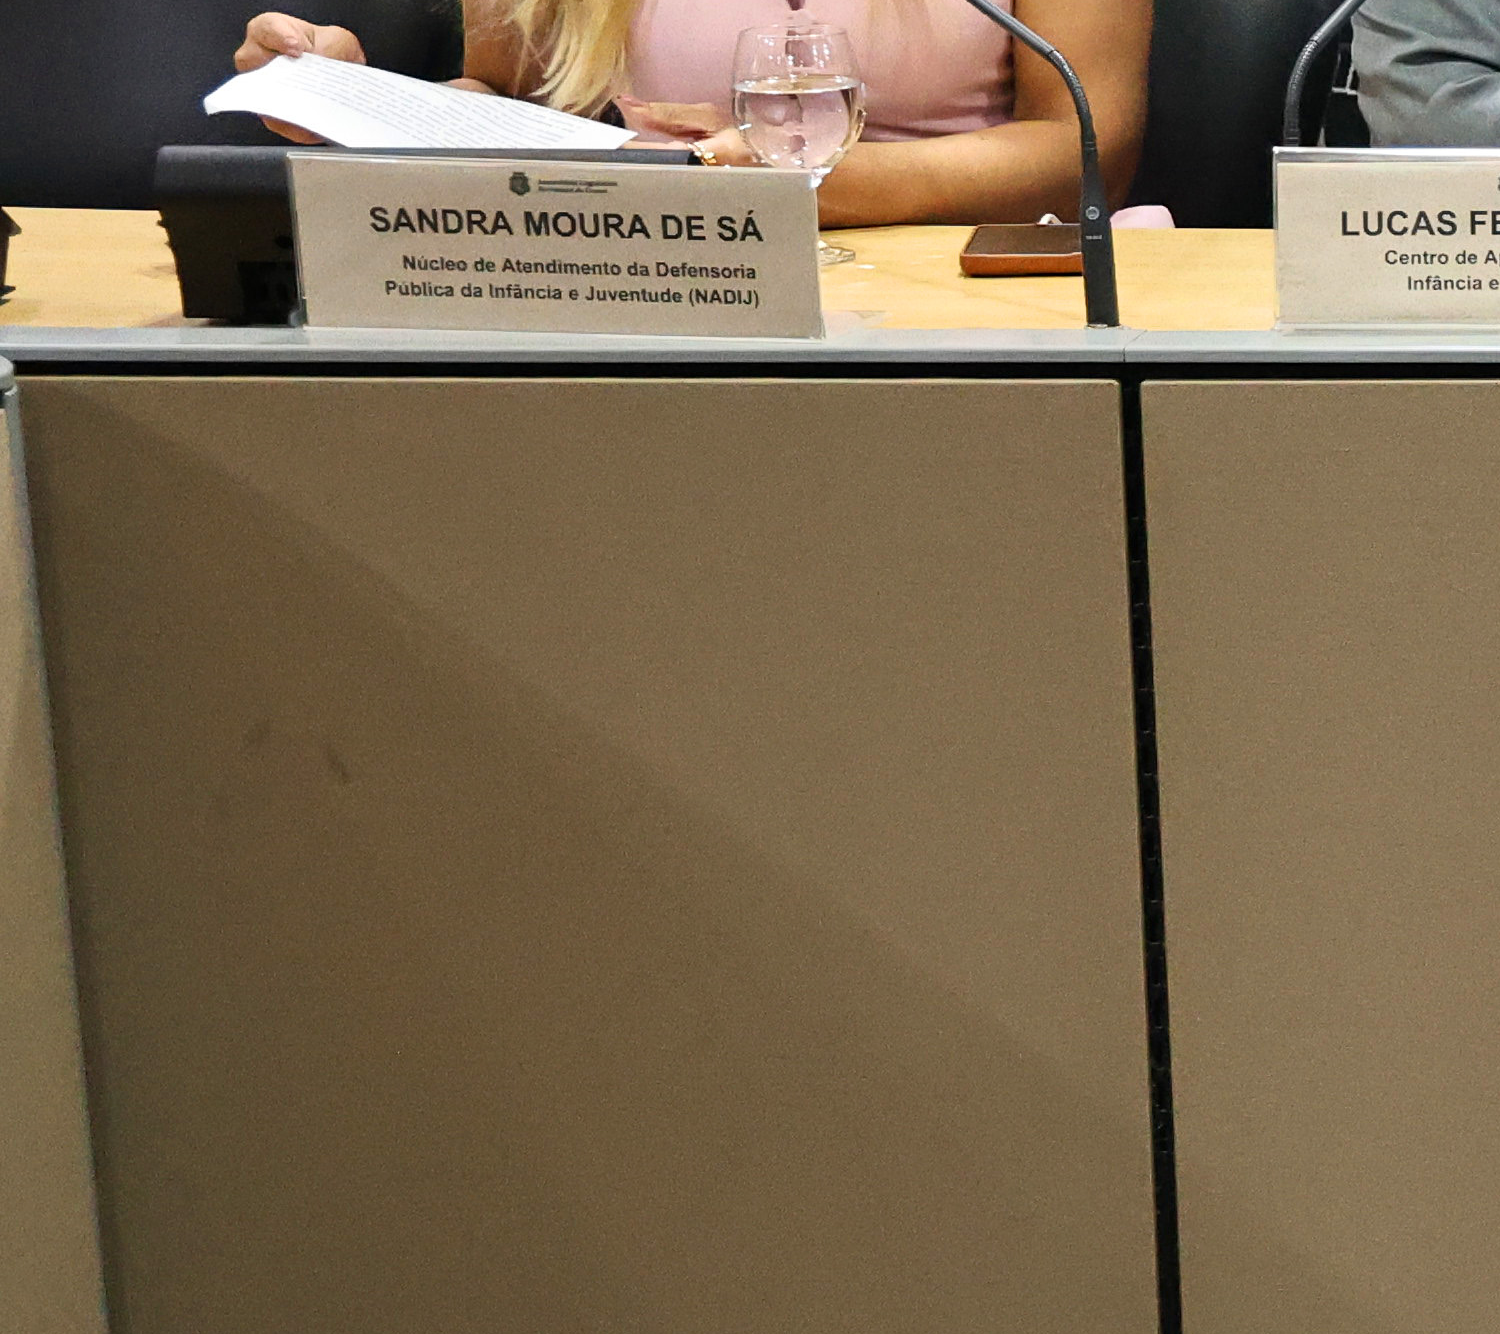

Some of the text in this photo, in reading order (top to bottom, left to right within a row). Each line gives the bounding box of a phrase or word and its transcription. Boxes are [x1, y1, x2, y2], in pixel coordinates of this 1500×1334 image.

[369, 206, 764, 242] SANDRA MOURA DE SÁ
[1341, 210, 1458, 237] LUCAS
[402, 254, 756, 280] Núcleo de Atendimento da Defensoria
[1384, 249, 1449, 265] Centro
[1454, 249, 1478, 265] de
[384, 280, 760, 309] Pública da Infância e Juventude (NADIJ)
[1407, 275, 1483, 291] Infância
[1488, 278, 1500, 291] e
